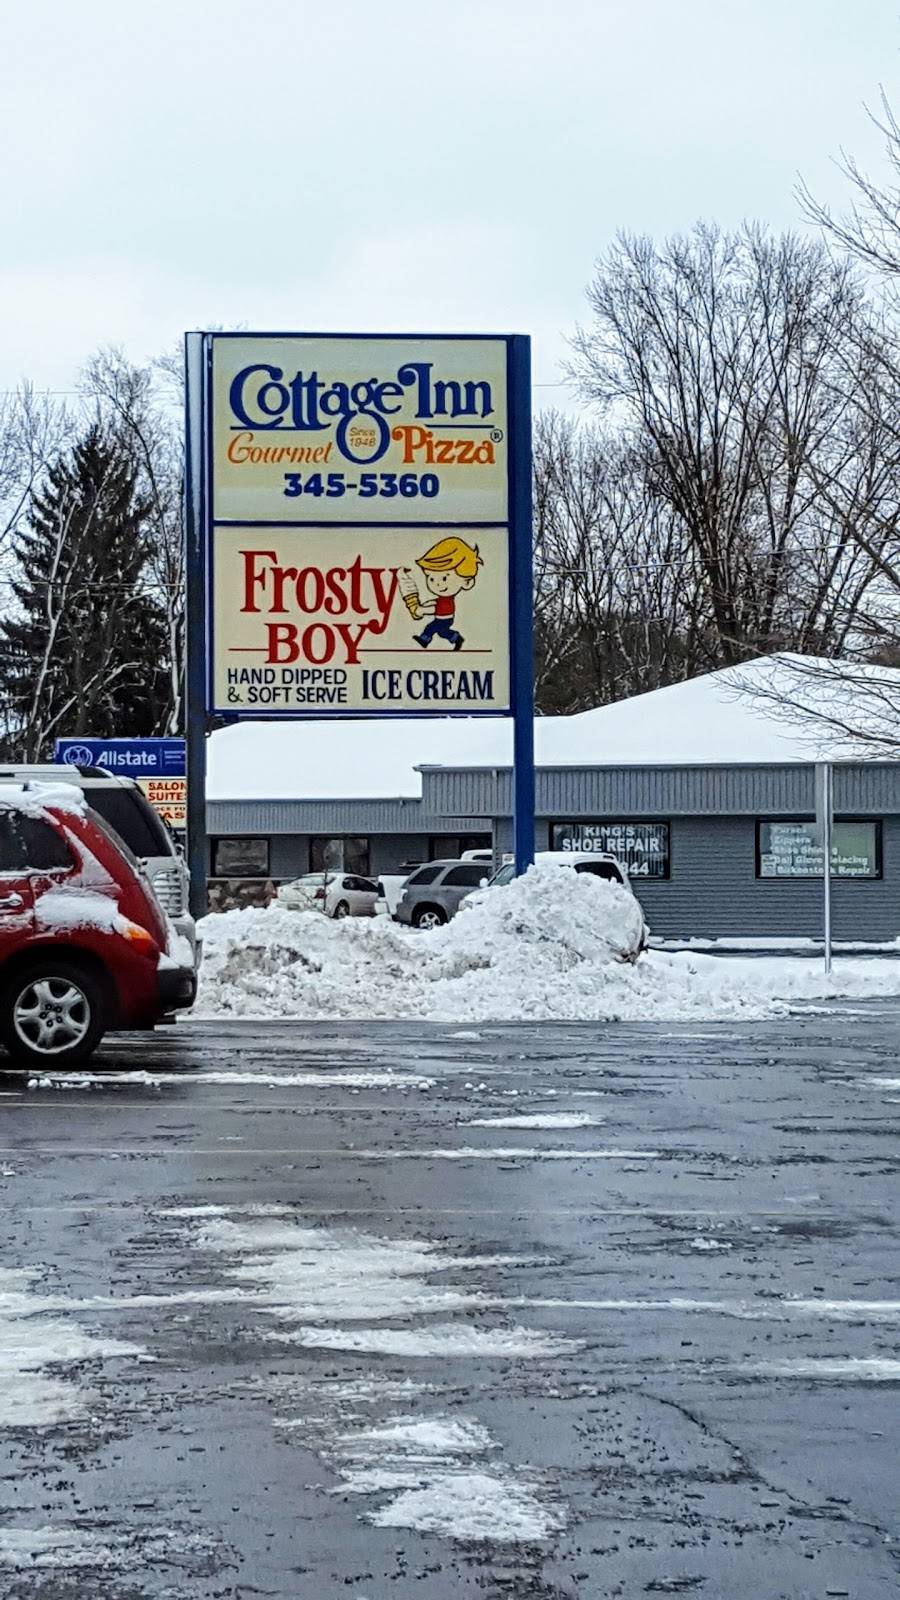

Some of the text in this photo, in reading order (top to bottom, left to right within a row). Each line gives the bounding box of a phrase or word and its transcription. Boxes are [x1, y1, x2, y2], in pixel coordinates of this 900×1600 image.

[230, 363, 495, 464] Cottage Inn
[227, 432, 334, 464] Gourmet
[392, 425, 495, 464] Pizza
[283, 473, 439, 497] 345-5360
[239, 550, 400, 634] Frosty
[265, 623, 369, 664] BOY
[227, 668, 347, 684] HAND DIPPED
[362, 669, 495, 700] ICE CREAM
[227, 687, 348, 703] & SOFT SERVE
[96, 750, 157, 766] Allstate
[148, 792, 187, 801] SUITE
[585, 826, 635, 837] KING'S
[562, 838, 660, 852] SHOE REPAIR
